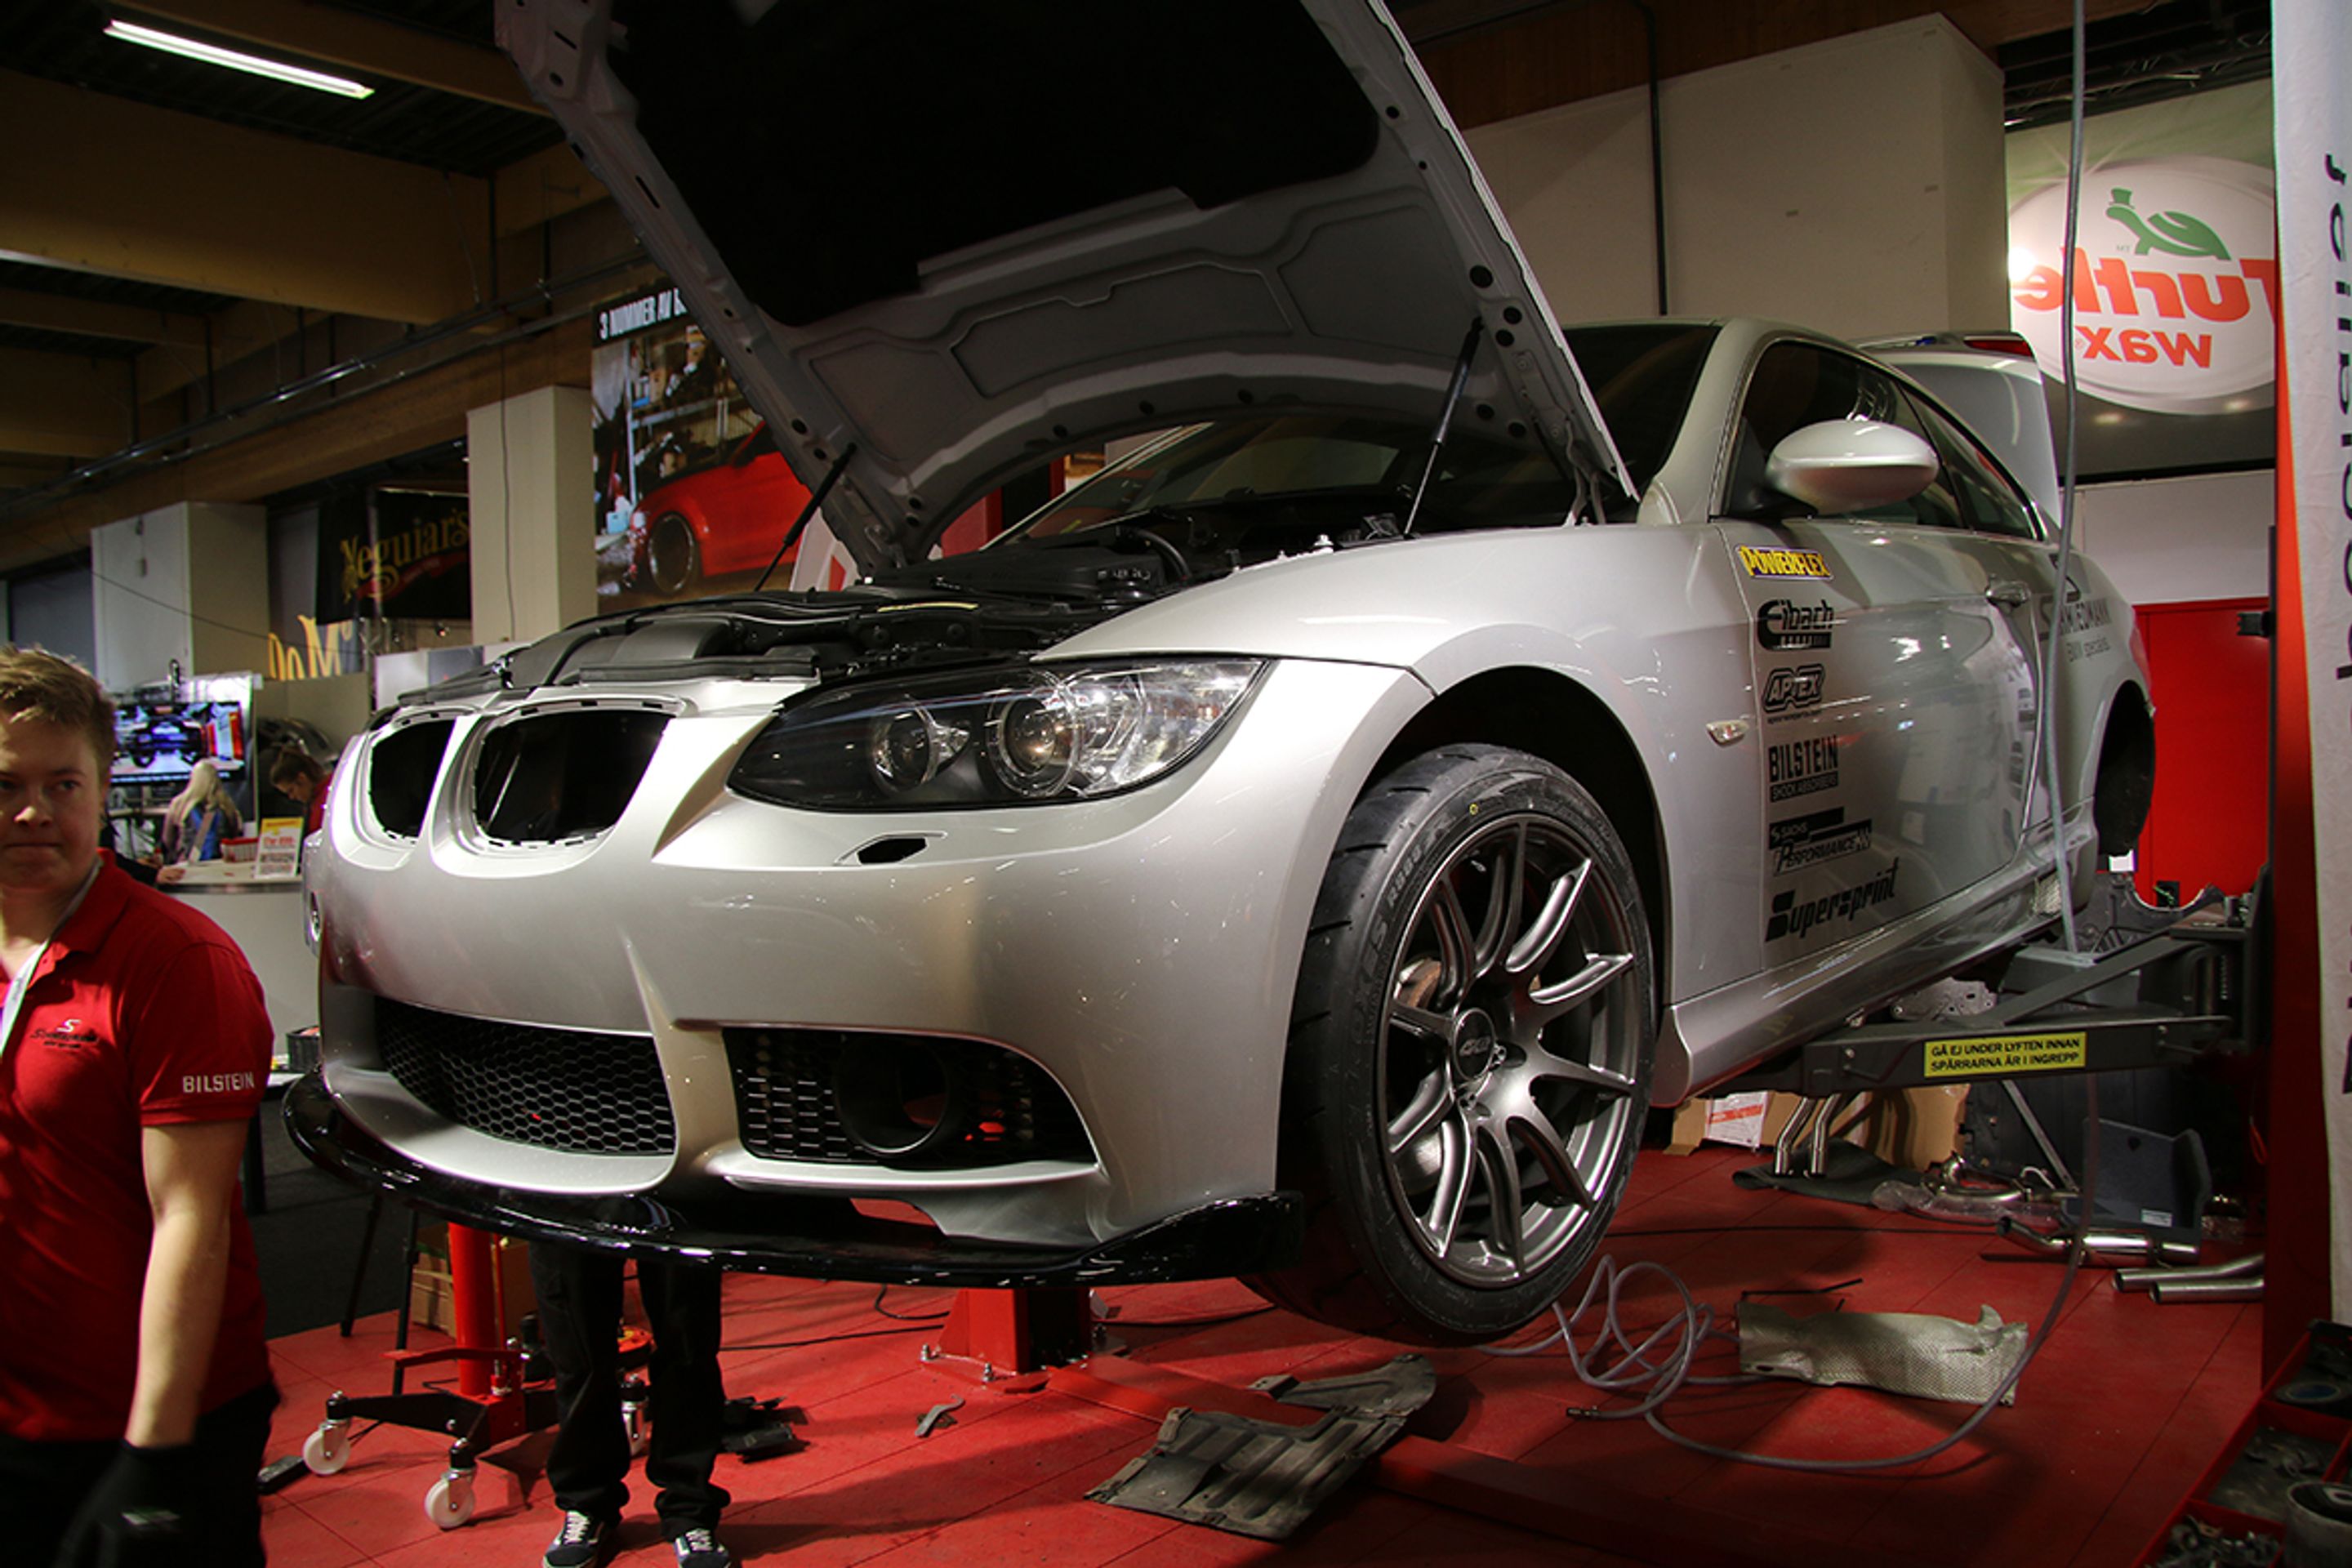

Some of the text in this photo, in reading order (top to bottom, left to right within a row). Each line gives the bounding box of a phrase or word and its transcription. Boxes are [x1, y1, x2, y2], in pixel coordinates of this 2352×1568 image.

[599, 311, 608, 340] 3
[1740, 546, 1831, 577] POWERFLEX
[1766, 670, 1823, 707] APEX
[1768, 734, 1838, 782] BILSTEIN
[1766, 856, 1899, 942] Supersprint
[1931, 1038, 2080, 1057] GÅ EJ UNDER LYFTEN INNAN
[2029, 1052, 2079, 1064] INGREPP
[182, 1071, 255, 1094] BILSTEIN
